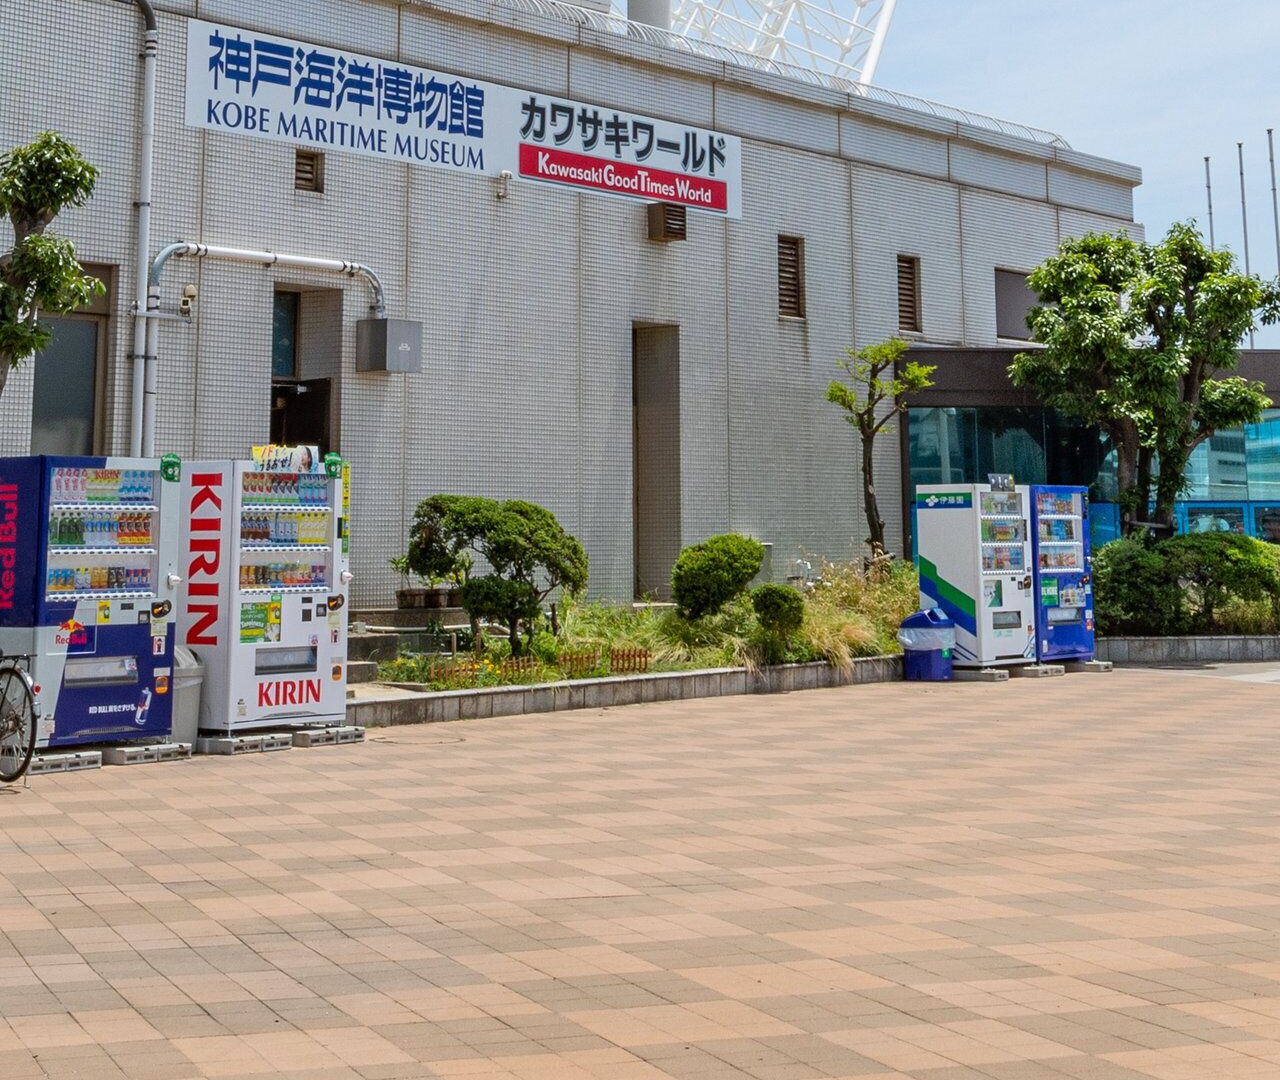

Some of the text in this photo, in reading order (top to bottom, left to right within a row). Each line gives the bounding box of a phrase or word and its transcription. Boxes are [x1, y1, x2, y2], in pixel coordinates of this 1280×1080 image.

[209, 30, 484, 138] 神戸海洋博物館
[207, 98, 484, 170] KOBE MARITIME MUSEUM
[520, 97, 727, 176] カワサキワールド
[537, 151, 712, 203] Kawasaki Good Times World
[186, 473, 222, 646] KIRIN
[258, 679, 321, 707] KIRIN
